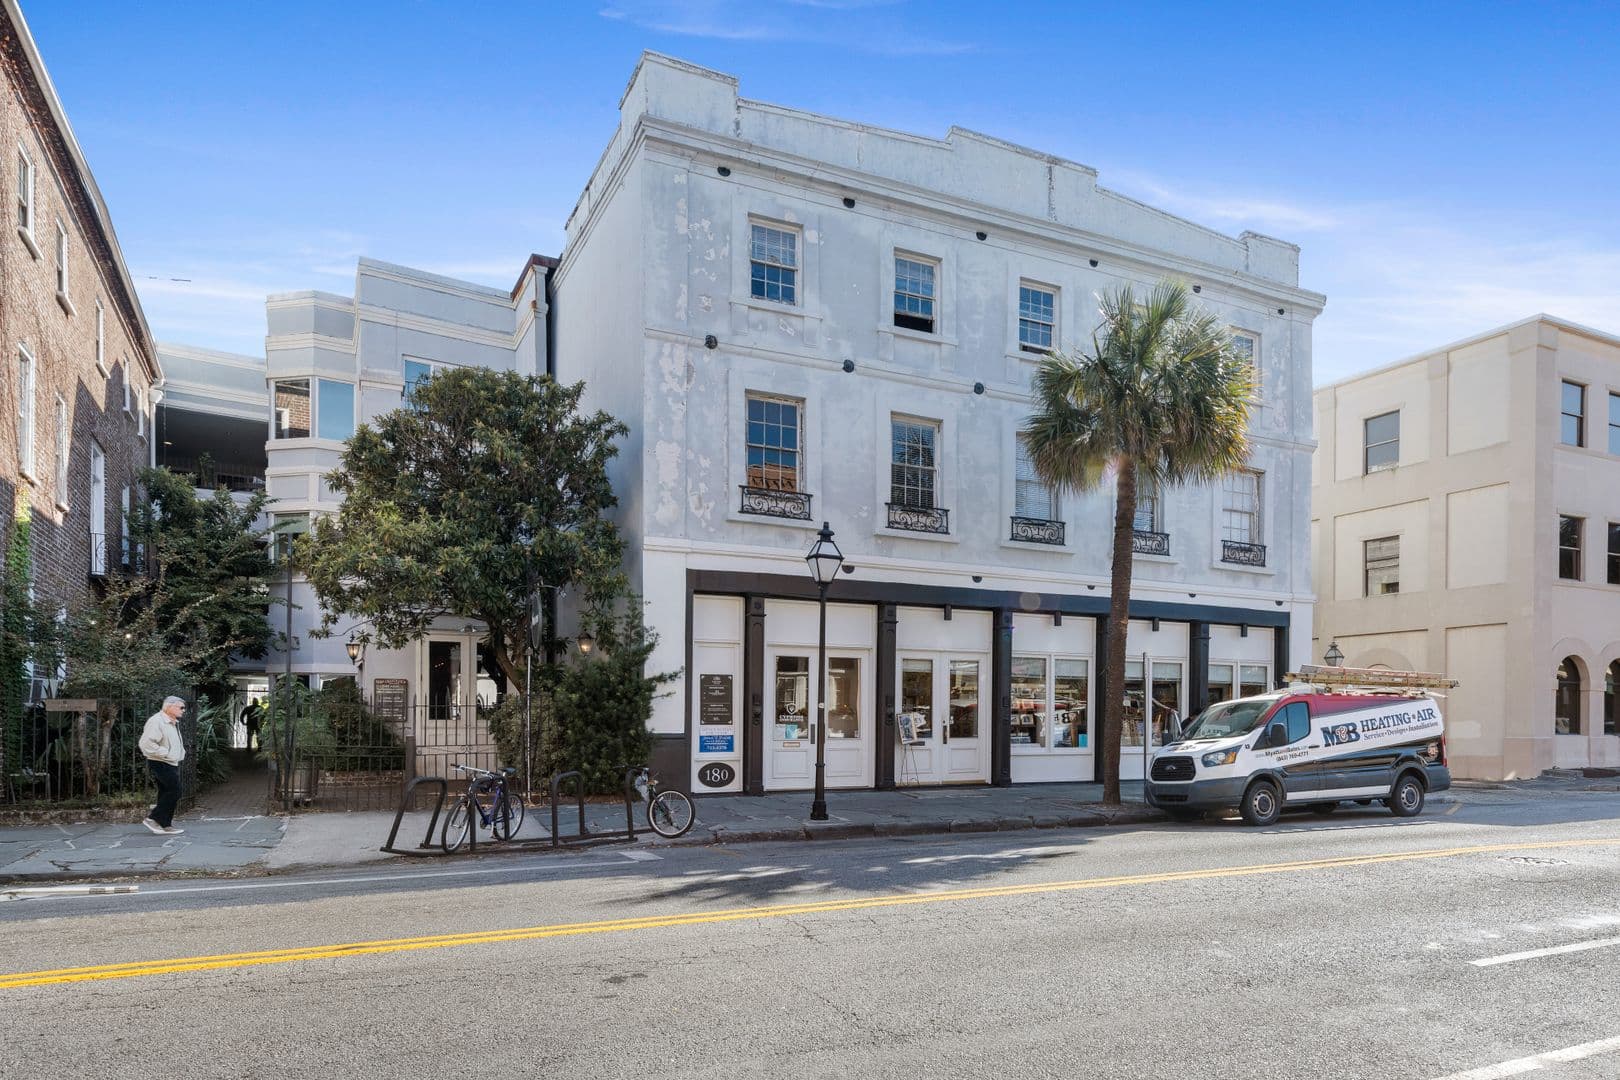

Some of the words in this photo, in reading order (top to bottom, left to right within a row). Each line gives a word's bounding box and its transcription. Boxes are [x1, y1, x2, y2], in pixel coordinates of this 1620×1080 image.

[1360, 712, 1412, 732] HEATING
[1417, 708, 1436, 721] AIR
[1364, 730, 1385, 740] Service
[1386, 725, 1407, 736] Design
[1408, 721, 1439, 732] Installation
[1320, 722, 1361, 747] M&B
[705, 767, 729, 782] 180
